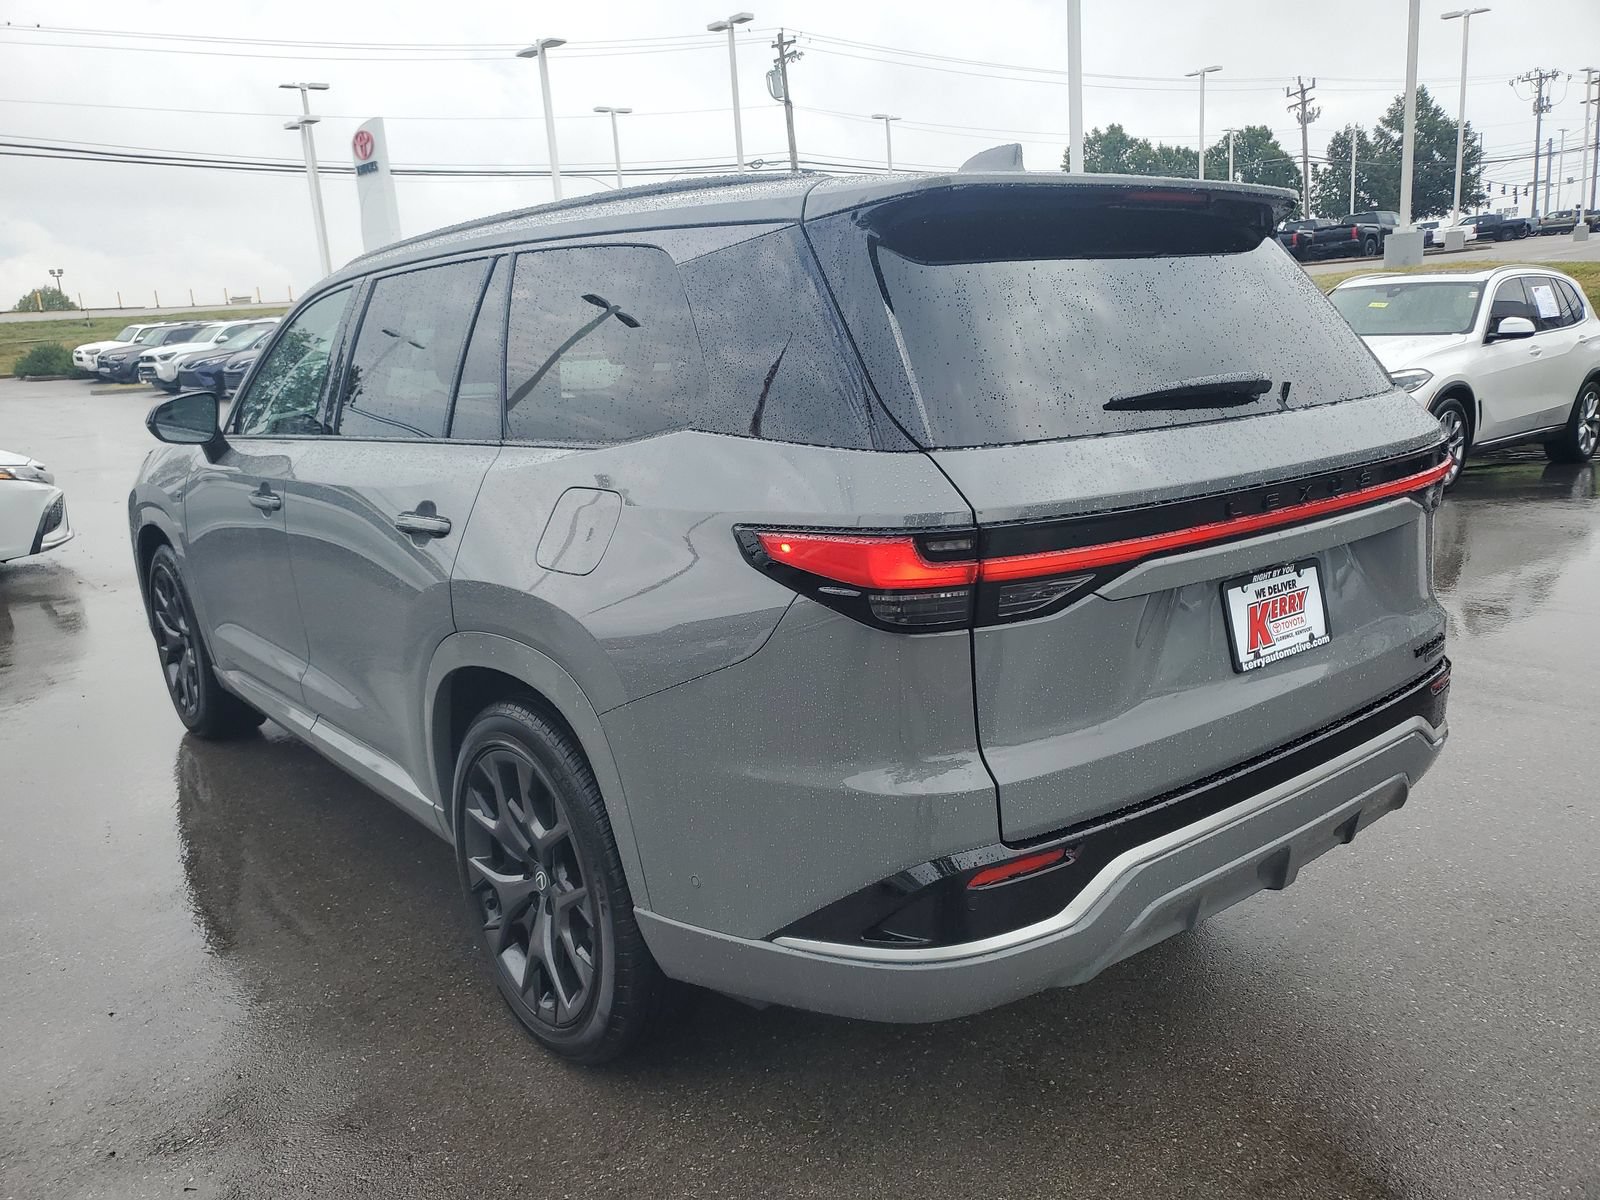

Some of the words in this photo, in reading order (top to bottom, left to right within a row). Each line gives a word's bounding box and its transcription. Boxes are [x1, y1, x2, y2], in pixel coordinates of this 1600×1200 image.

[1252, 571, 1272, 582] RIGHT
[1272, 569, 1281, 578] BY
[1282, 564, 1295, 575] YOU
[1255, 587, 1266, 599] WE
[1268, 579, 1297, 595] DELIVER
[1248, 589, 1308, 652] KERRY
[1281, 616, 1305, 629] TOYOTA
[1242, 635, 1330, 672] kerryautomotive.com
